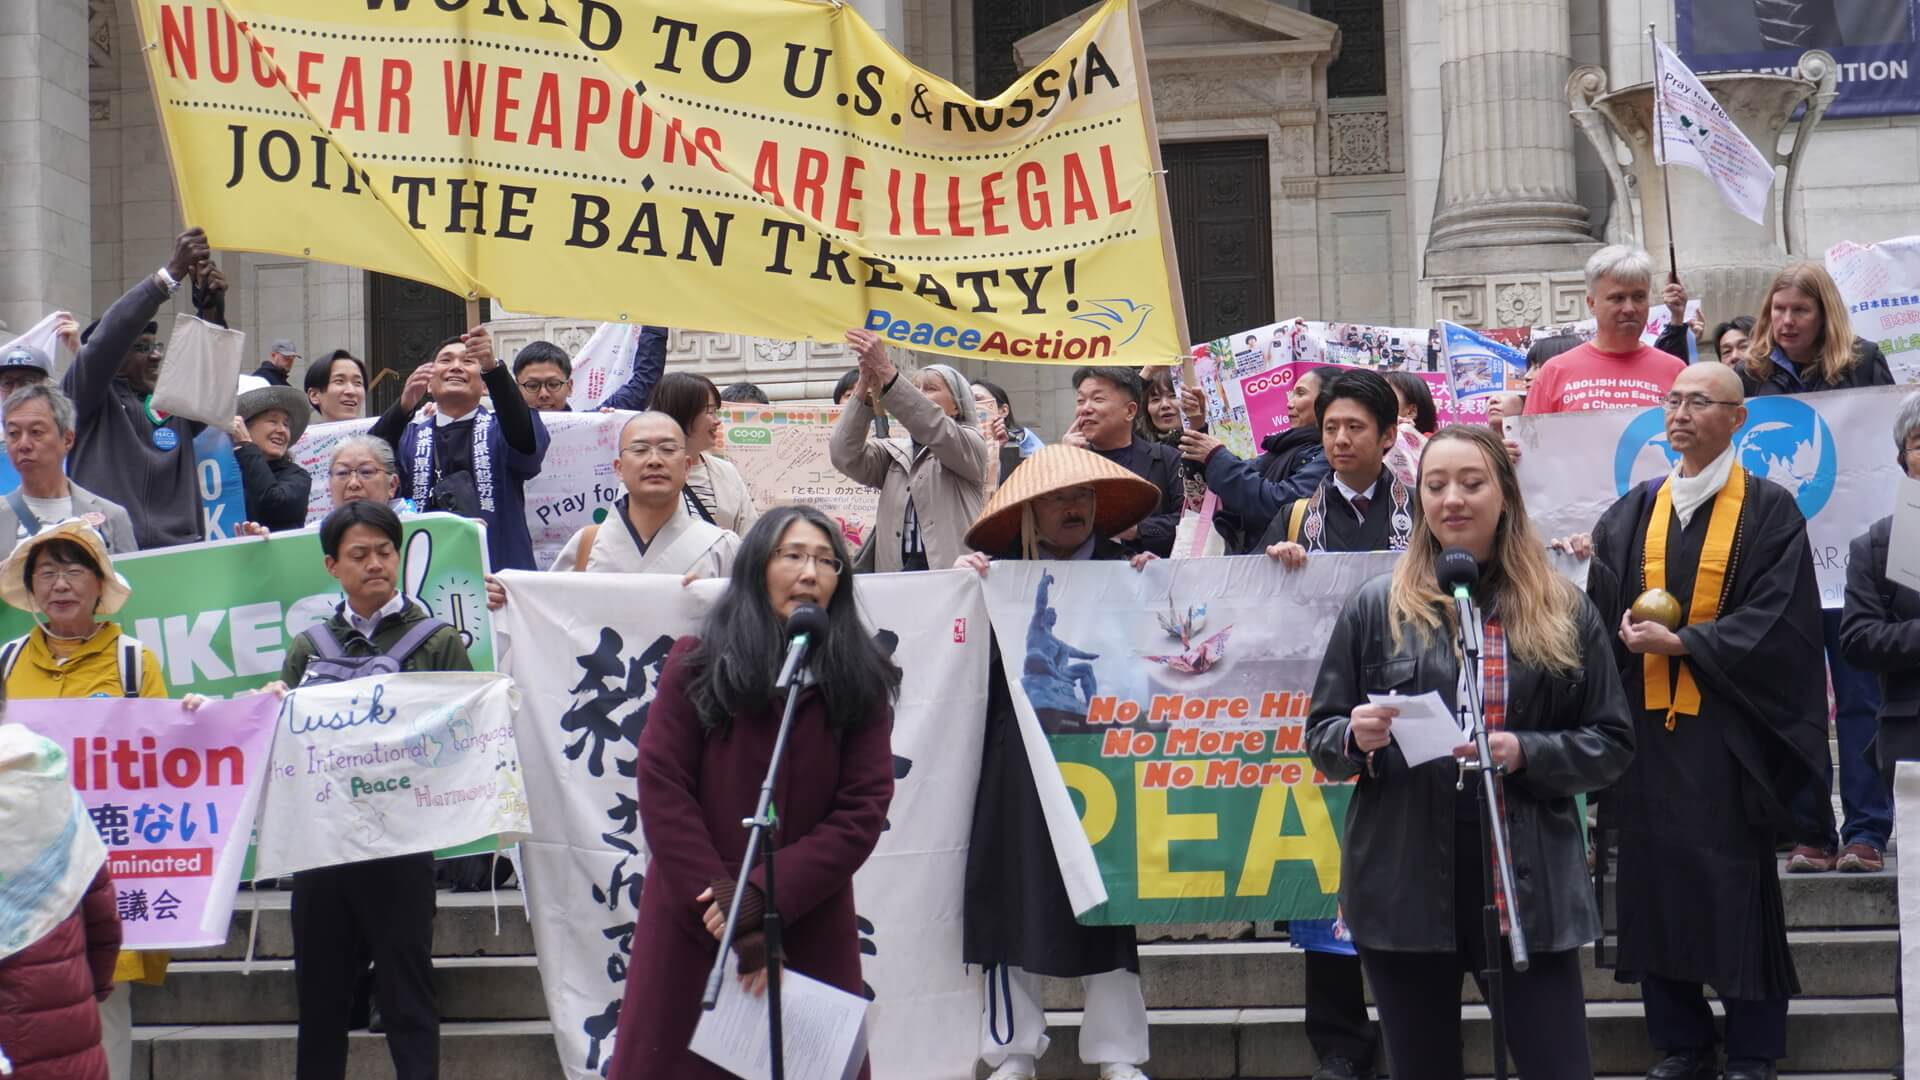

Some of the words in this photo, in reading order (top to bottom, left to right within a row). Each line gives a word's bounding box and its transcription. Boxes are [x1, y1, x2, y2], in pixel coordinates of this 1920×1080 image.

[653, 16, 751, 84] TO
[783, 43, 901, 125] U.S.
[911, 83, 932, 124] &
[1665, 72, 1691, 95] Pray
[753, 140, 865, 232] ARE
[888, 144, 1132, 238] ILLEGAL
[392, 176, 537, 242] THE
[564, 193, 735, 267] BAN
[762, 218, 1079, 314] TREATY!
[1563, 391, 1586, 405] Give
[1588, 389, 1611, 398] Life
[1614, 391, 1629, 399] on
[1564, 379, 1616, 391] ABOLISH
[1619, 379, 1662, 393] NUKES.
[1583, 402, 1590, 410] a
[536, 492, 586, 525] Pray
[1088, 697, 1138, 723] No
[1151, 694, 1248, 720] More
[1103, 729, 1154, 755] No
[1165, 727, 1264, 754] More
[307, 735, 430, 776] International
[1144, 762, 1193, 787] No
[1206, 760, 1302, 786] More
[316, 783, 332, 803] of
[351, 775, 412, 798] Peace
